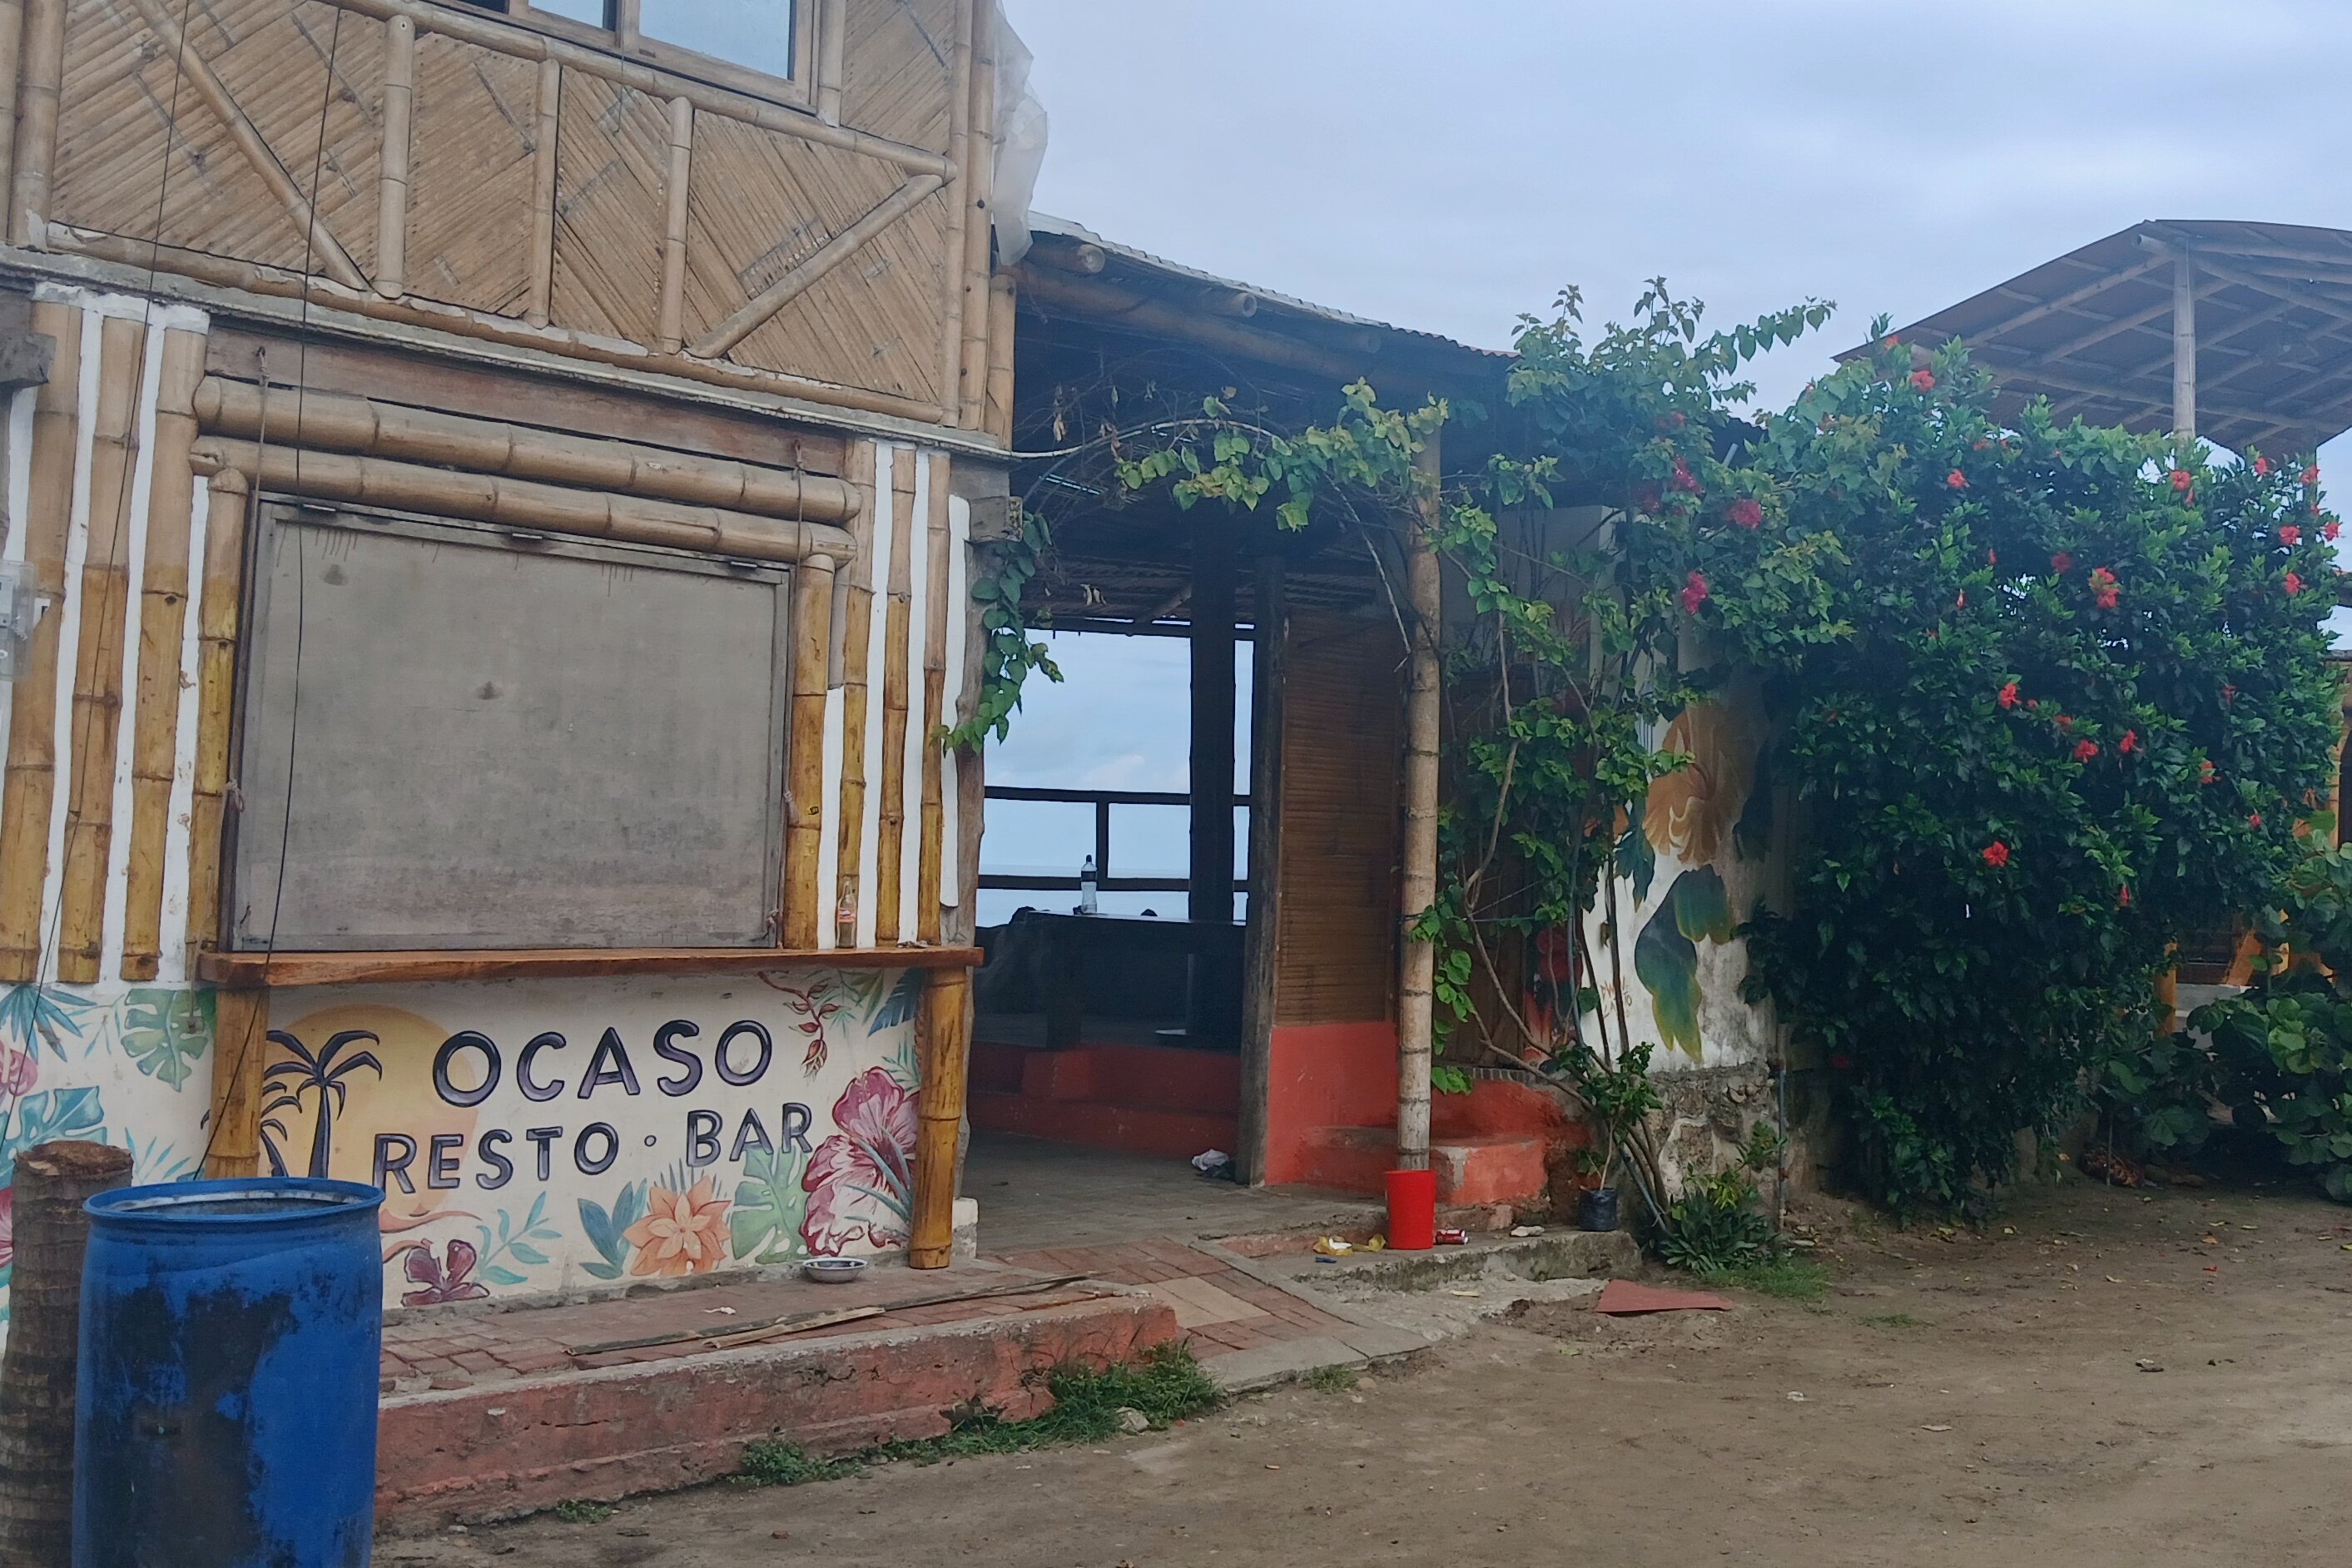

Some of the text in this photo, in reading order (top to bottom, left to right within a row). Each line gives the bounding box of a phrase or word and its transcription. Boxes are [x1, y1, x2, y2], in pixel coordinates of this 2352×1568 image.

[433, 1020, 772, 1108] OCASO
[372, 1121, 619, 1193] RESTO
[687, 1103, 813, 1167] BAR
